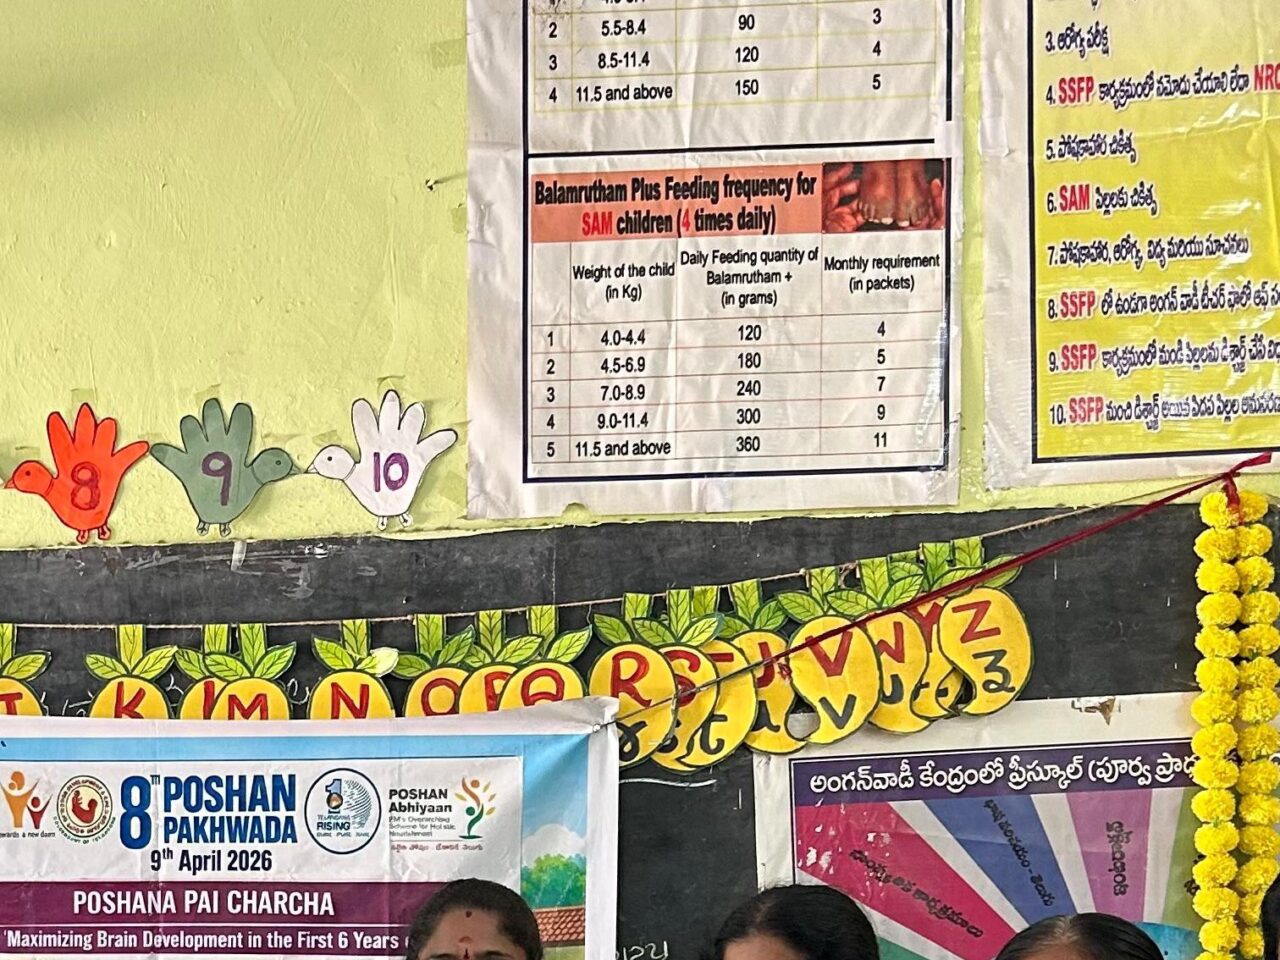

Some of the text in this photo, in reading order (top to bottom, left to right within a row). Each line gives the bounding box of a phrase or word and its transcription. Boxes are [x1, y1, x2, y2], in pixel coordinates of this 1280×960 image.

[601, 20, 646, 37] 5.5-8.4
[738, 15, 755, 30] 90
[598, 51, 650, 68] 8.5-11.4
[735, 47, 759, 63] 120
[576, 84, 673, 102] 11.5 and above
[735, 80, 759, 96] 150
[1058, 76, 1094, 104] SSFP
[534, 171, 816, 204] Balamrutham Plus Feeding frequency for
[1059, 184, 1090, 211] SAM
[582, 206, 775, 238] SAM children (4 times daily)
[681, 246, 818, 269] Daily Feeding quantity of
[824, 254, 940, 273] Monthly requirement
[572, 260, 675, 282] Weight of the child
[707, 270, 781, 286] Balamrutham
[605, 283, 642, 301] (in Kg)
[849, 275, 914, 293] (in packets)
[721, 290, 777, 307] (in grams)
[1060, 291, 1095, 318] SSFP
[601, 330, 645, 346] 4.0-4.4
[738, 325, 761, 341] 120
[601, 357, 645, 374] 4.5-6.9
[738, 353, 761, 369] 180
[1061, 343, 1097, 371] SSFP
[600, 384, 645, 401] 7.0-8.9
[737, 380, 761, 396] 240
[737, 408, 761, 425] 300
[1070, 396, 1104, 423] SSFP
[597, 412, 648, 429] 9.0-11.4
[575, 439, 671, 457] 11.5 and above
[736, 436, 760, 452] 360
[202, 452, 231, 506] 9
[373, 452, 404, 493] 10
[70, 463, 101, 509] 8
[952, 600, 1000, 643] Z
[806, 632, 853, 677] V
[228, 693, 269, 720] M
[331, 682, 369, 719] N
[821, 695, 855, 729] v
[919, 757, 1005, 793] కేంద్రంలో
[1008, 755, 1083, 790] ప్రీస్కూల్
[1089, 756, 1151, 785] (పూర్వ
[164, 774, 296, 813] POSHAN
[389, 788, 448, 800] POSHAN
[389, 802, 452, 815] Abhiyaan
[164, 816, 298, 844] PAKHWADA
[317, 822, 350, 830] RISING
[179, 850, 222, 876] April
[227, 850, 272, 872] 2026
[73, 889, 335, 916] POSHANA PAI CHARCHA
[97, 930, 137, 948] Brain
[142, 930, 243, 951] Development
[248, 931, 263, 948] in
[267, 931, 292, 948] the
[296, 931, 334, 948] First
[338, 931, 348, 949] 6
[353, 931, 399, 949] Years
